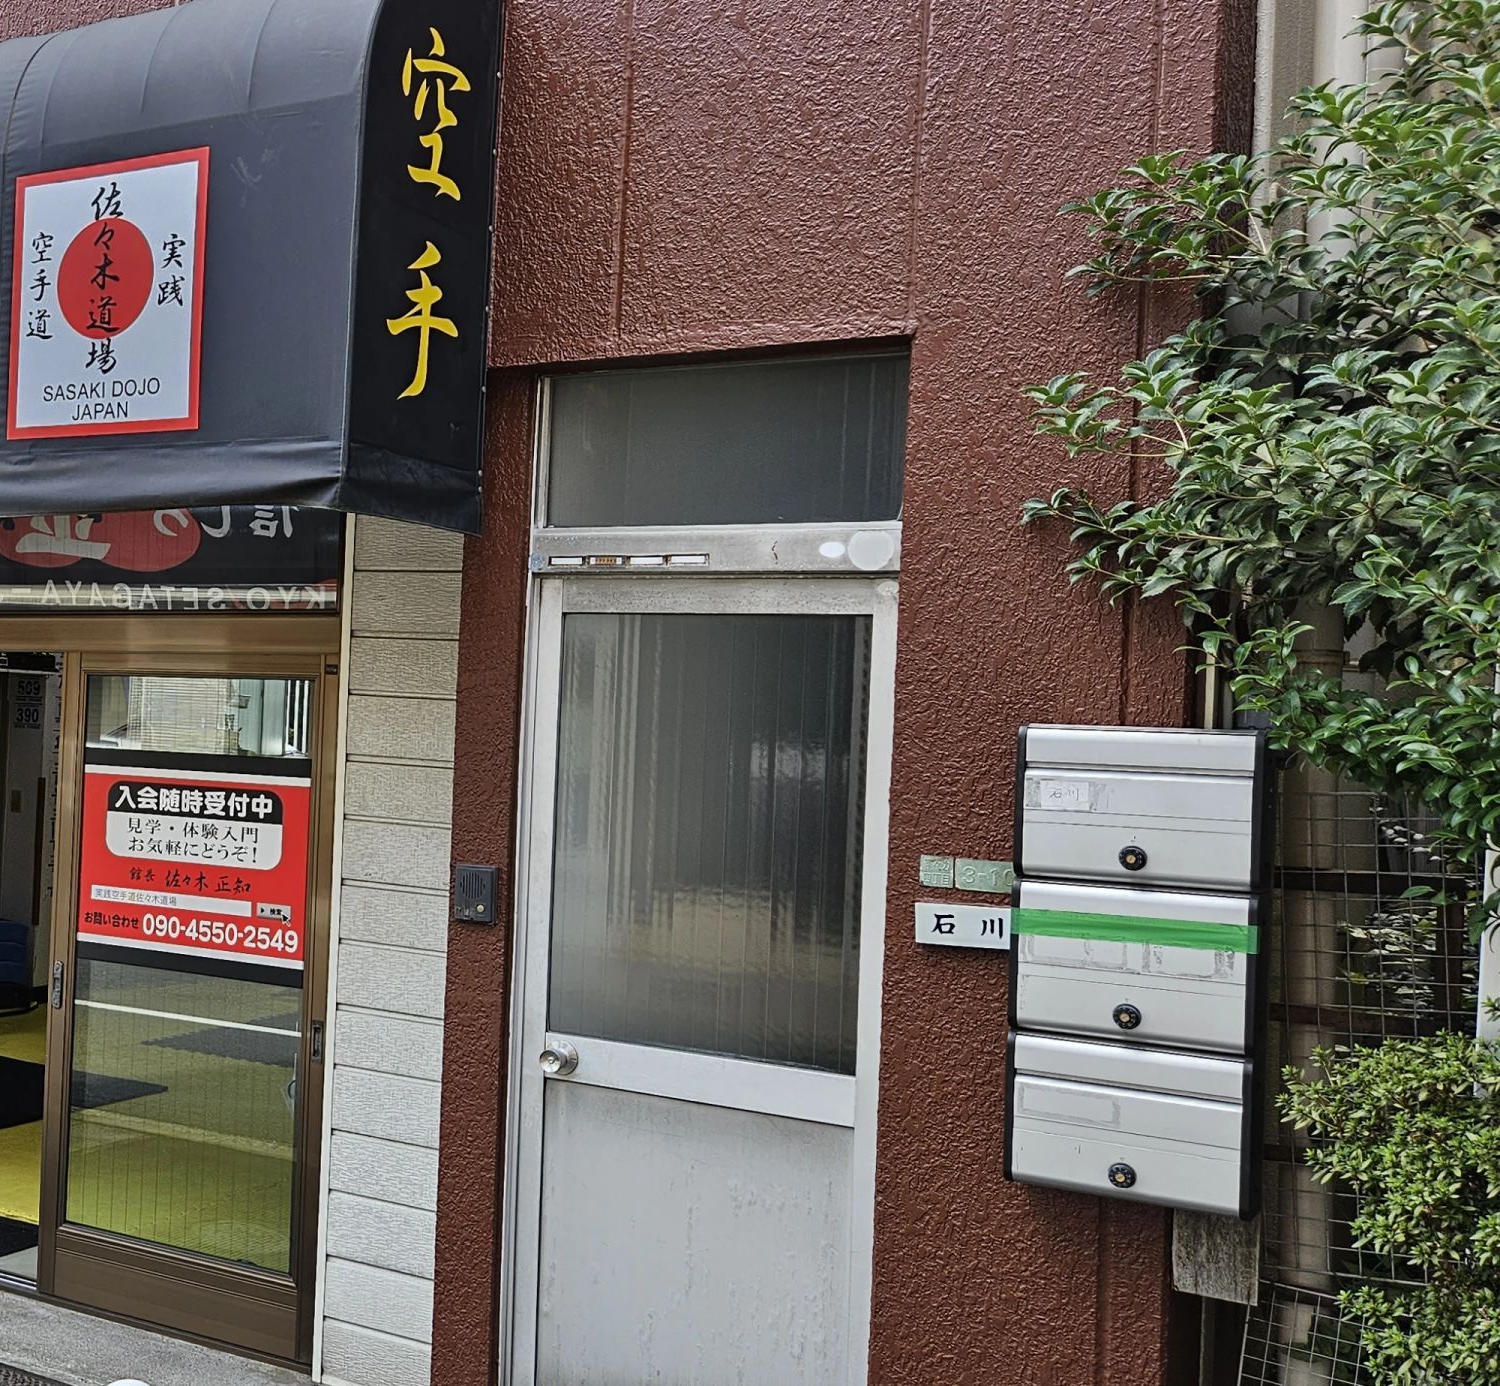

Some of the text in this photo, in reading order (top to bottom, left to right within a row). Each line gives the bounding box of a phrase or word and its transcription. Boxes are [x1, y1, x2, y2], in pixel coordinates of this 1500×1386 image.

[385, 26, 472, 400] 空手
[85, 181, 125, 375] 佐々木道場
[156, 233, 187, 306] 実践
[25, 231, 54, 340] 空手道
[42, 377, 161, 402] SASAKI DOJO
[71, 401, 129, 422] JAPAN
[115, 785, 273, 819] 入会随時受付中
[128, 817, 259, 843] 見学・体験入門
[164, 868, 209, 892] 佐々木
[94, 887, 177, 907] 実践空手道佐々木道場
[84, 911, 299, 953] お問い合わせ 090-4550-2549
[931, 913, 1004, 940] 石川
